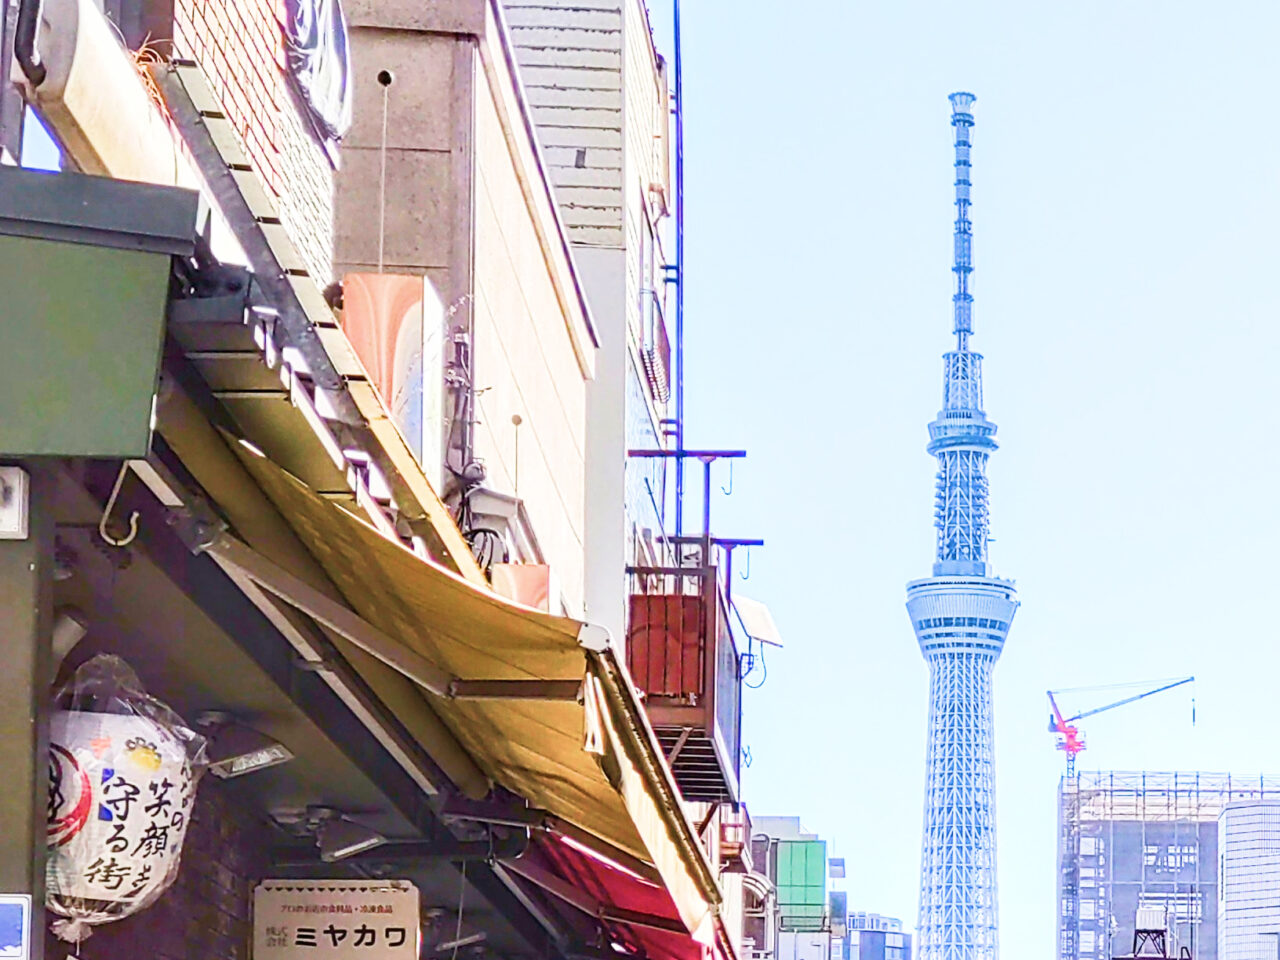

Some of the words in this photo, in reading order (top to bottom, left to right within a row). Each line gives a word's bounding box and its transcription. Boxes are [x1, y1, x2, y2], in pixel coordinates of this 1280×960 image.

[84, 776, 140, 890] 守る街
[294, 923, 406, 947] ミヤカワ
